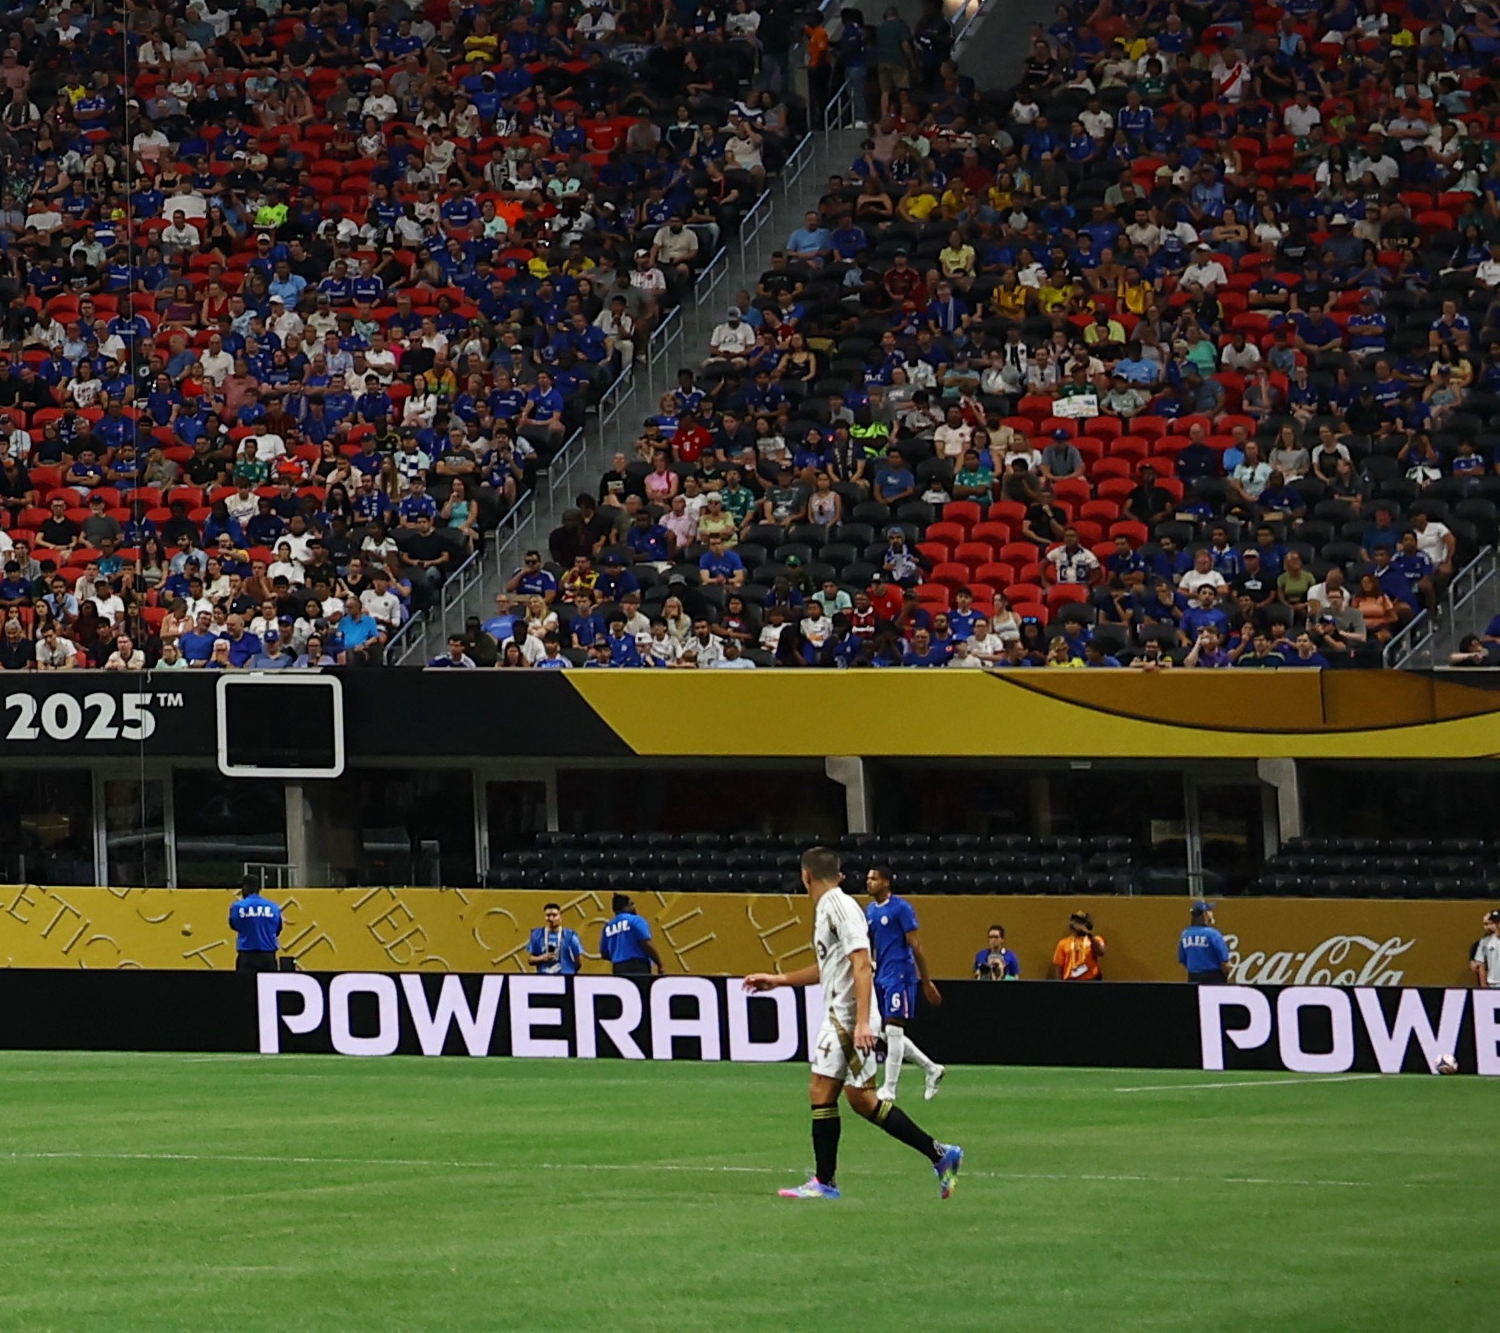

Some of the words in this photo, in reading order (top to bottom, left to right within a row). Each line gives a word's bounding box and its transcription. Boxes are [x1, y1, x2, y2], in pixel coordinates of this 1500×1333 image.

[5, 693, 184, 741] 2025™
[238, 906, 275, 919] S.A.F.E.
[890, 991, 901, 1009] 6
